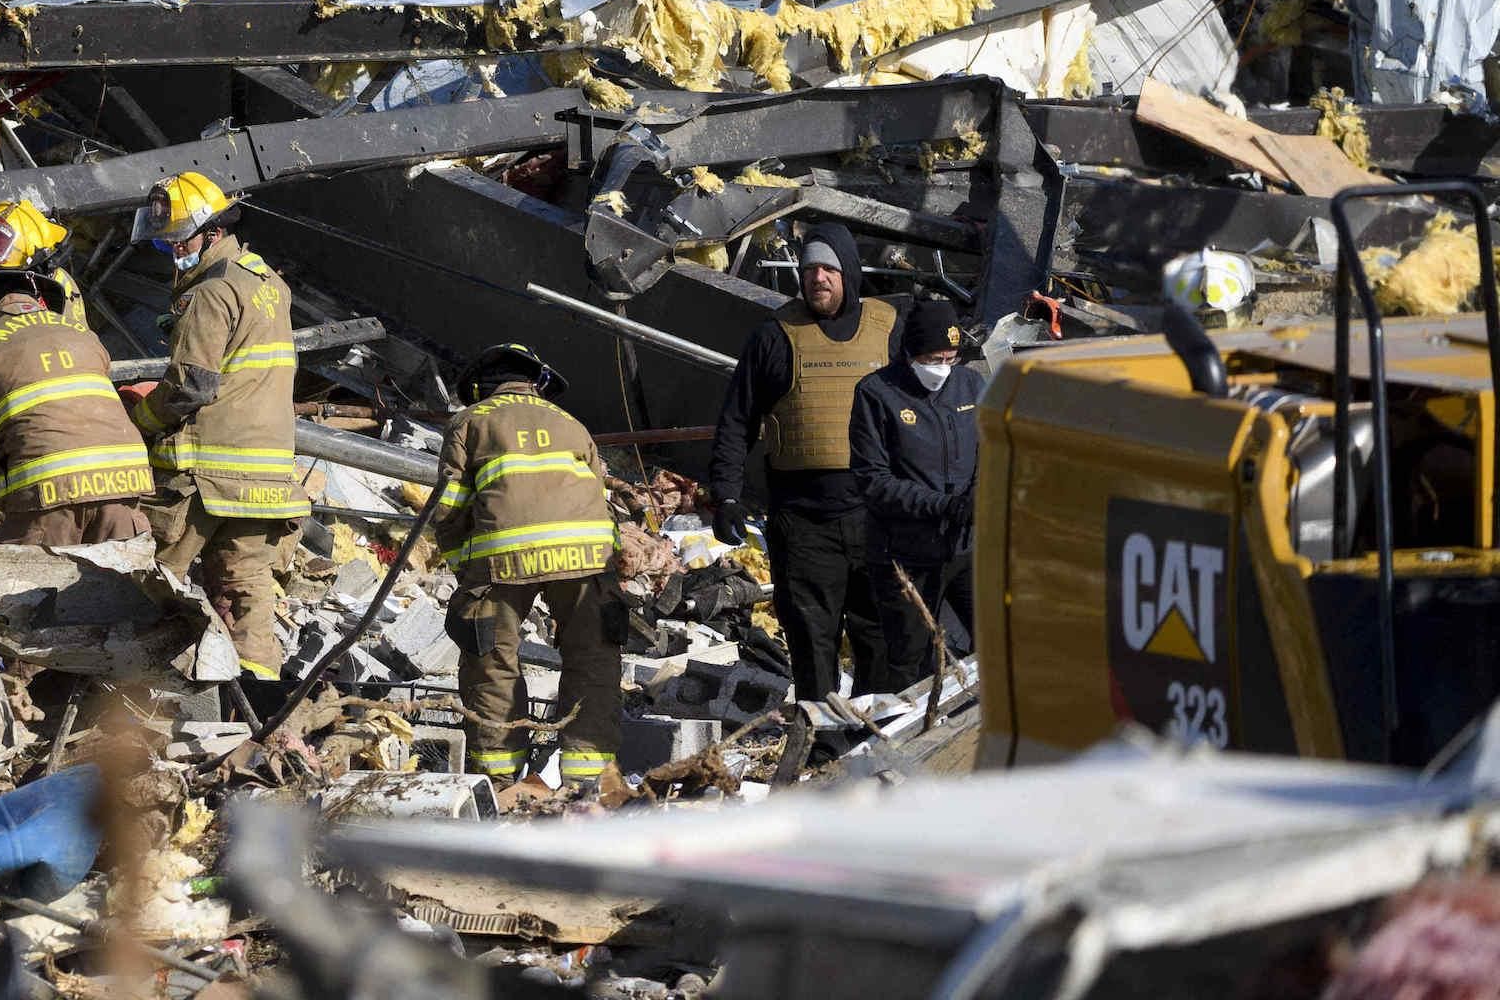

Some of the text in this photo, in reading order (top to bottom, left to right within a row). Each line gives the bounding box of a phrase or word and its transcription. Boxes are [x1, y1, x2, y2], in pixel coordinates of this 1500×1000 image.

[472, 394, 574, 421] MAYFIELD
[41, 468, 152, 505] D. JACKSON
[238, 487, 294, 504] LINDSEY
[499, 544, 606, 580] J. WOMBLE
[1122, 532, 1224, 664] CAT
[1166, 680, 1228, 750] 323
